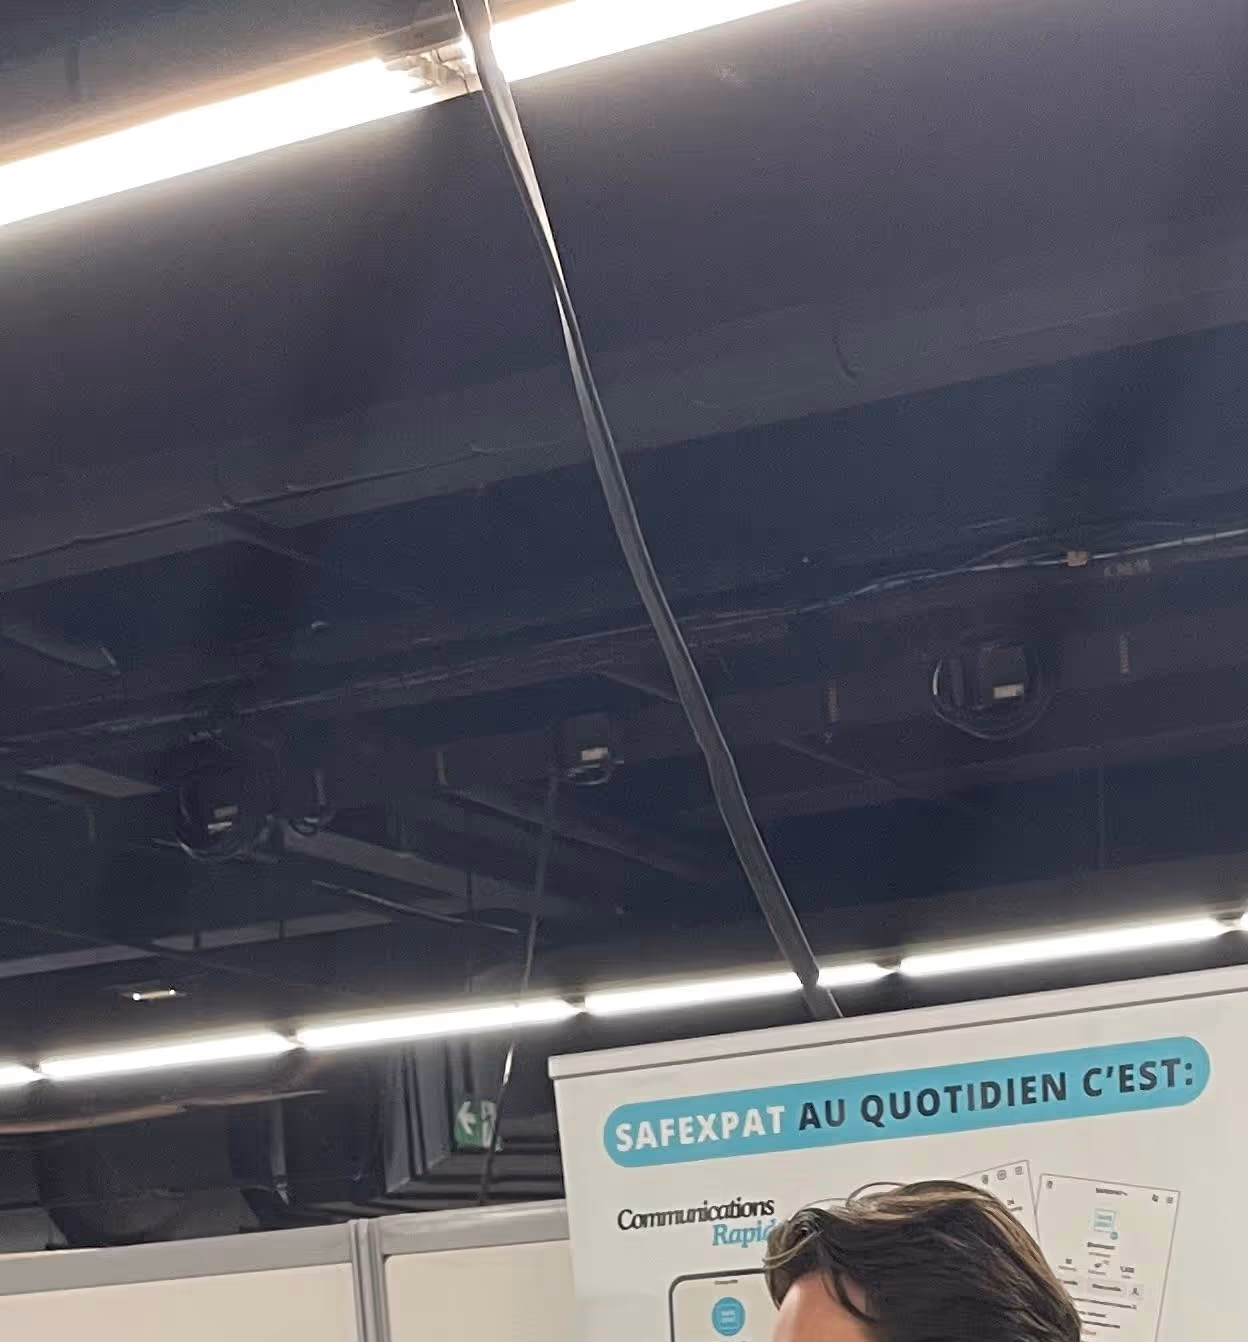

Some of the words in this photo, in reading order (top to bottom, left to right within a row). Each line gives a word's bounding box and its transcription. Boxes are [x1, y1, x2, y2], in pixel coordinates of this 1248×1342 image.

[615, 1106, 784, 1152] SAFEXPAT
[799, 1094, 847, 1132] AU
[860, 1071, 1067, 1129] QUOTIDIEN
[617, 1196, 775, 1231] Communications
